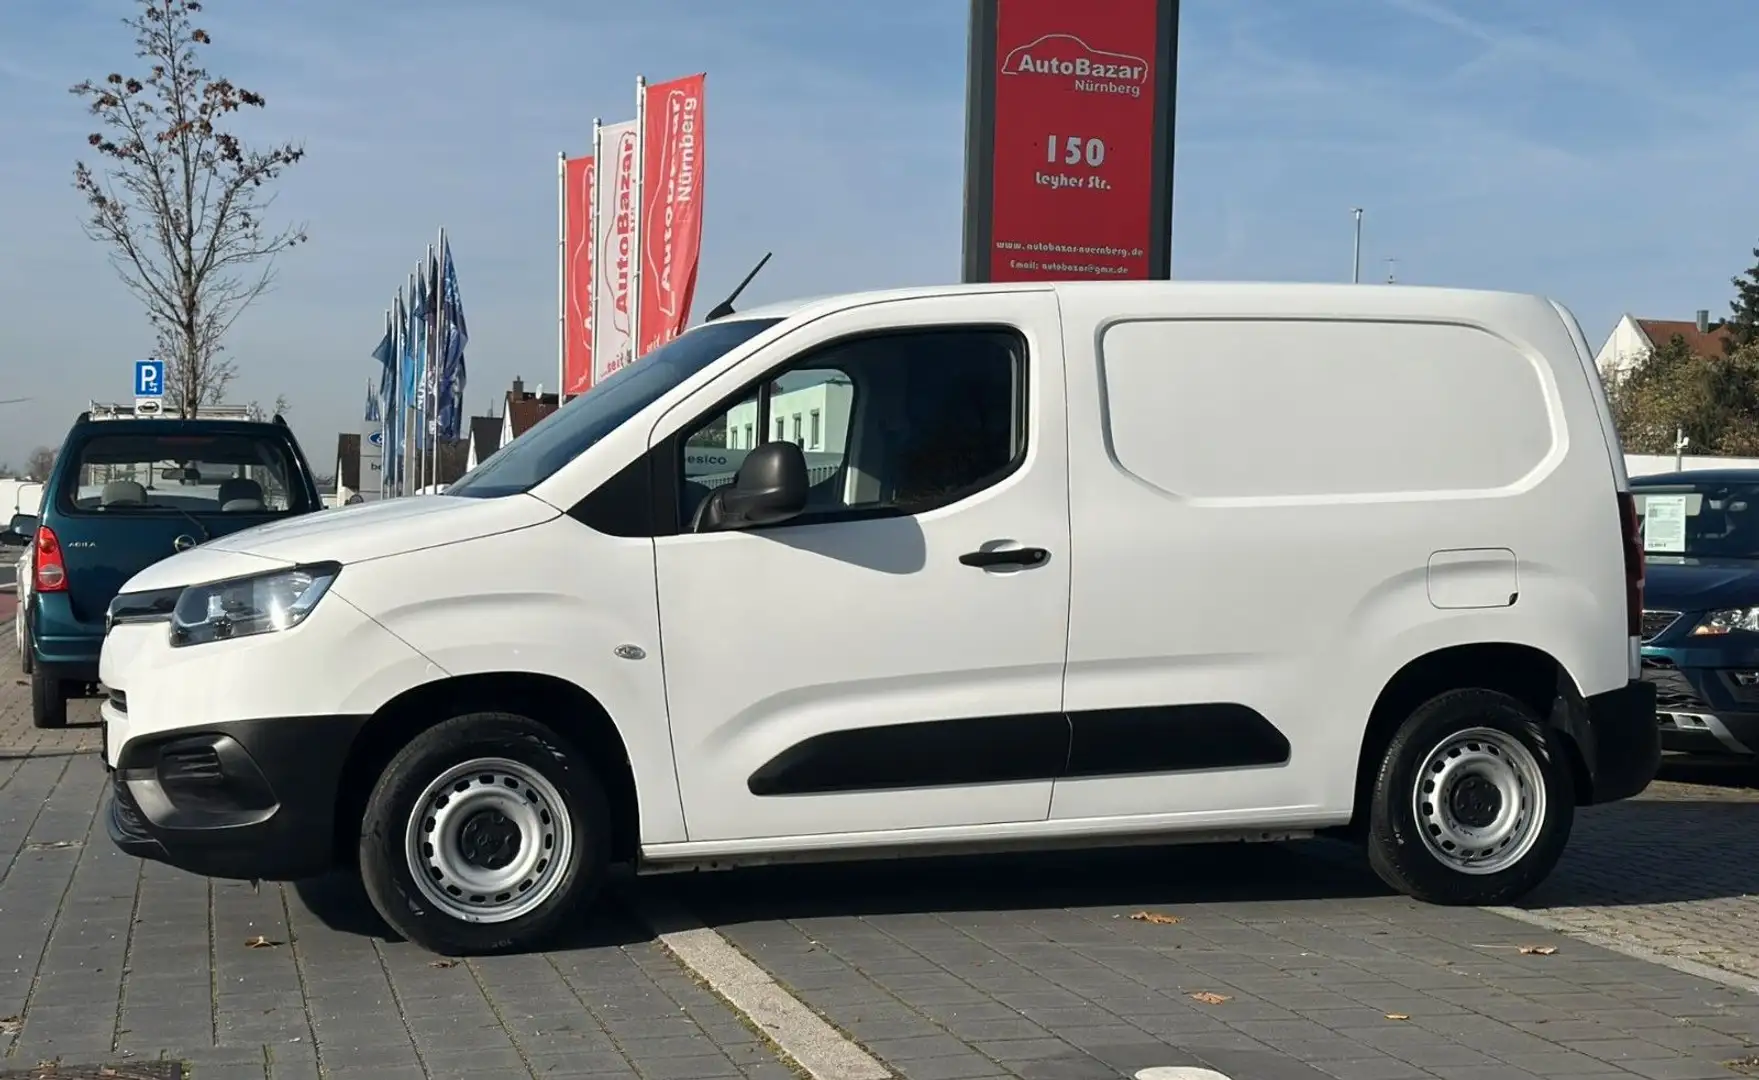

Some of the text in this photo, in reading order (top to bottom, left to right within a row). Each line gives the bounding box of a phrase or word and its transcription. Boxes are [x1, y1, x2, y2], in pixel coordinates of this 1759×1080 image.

[1018, 54, 1143, 79] AutoBazar
[1074, 79, 1140, 97] Nürnberg
[677, 97, 698, 202] Nürnberg
[1047, 134, 1105, 167] 150
[1035, 171, 1112, 190] Leyher Str.
[615, 139, 635, 314] AutoBazar
[1010, 260, 1039, 270] Email:
[141, 365, 157, 391] P
